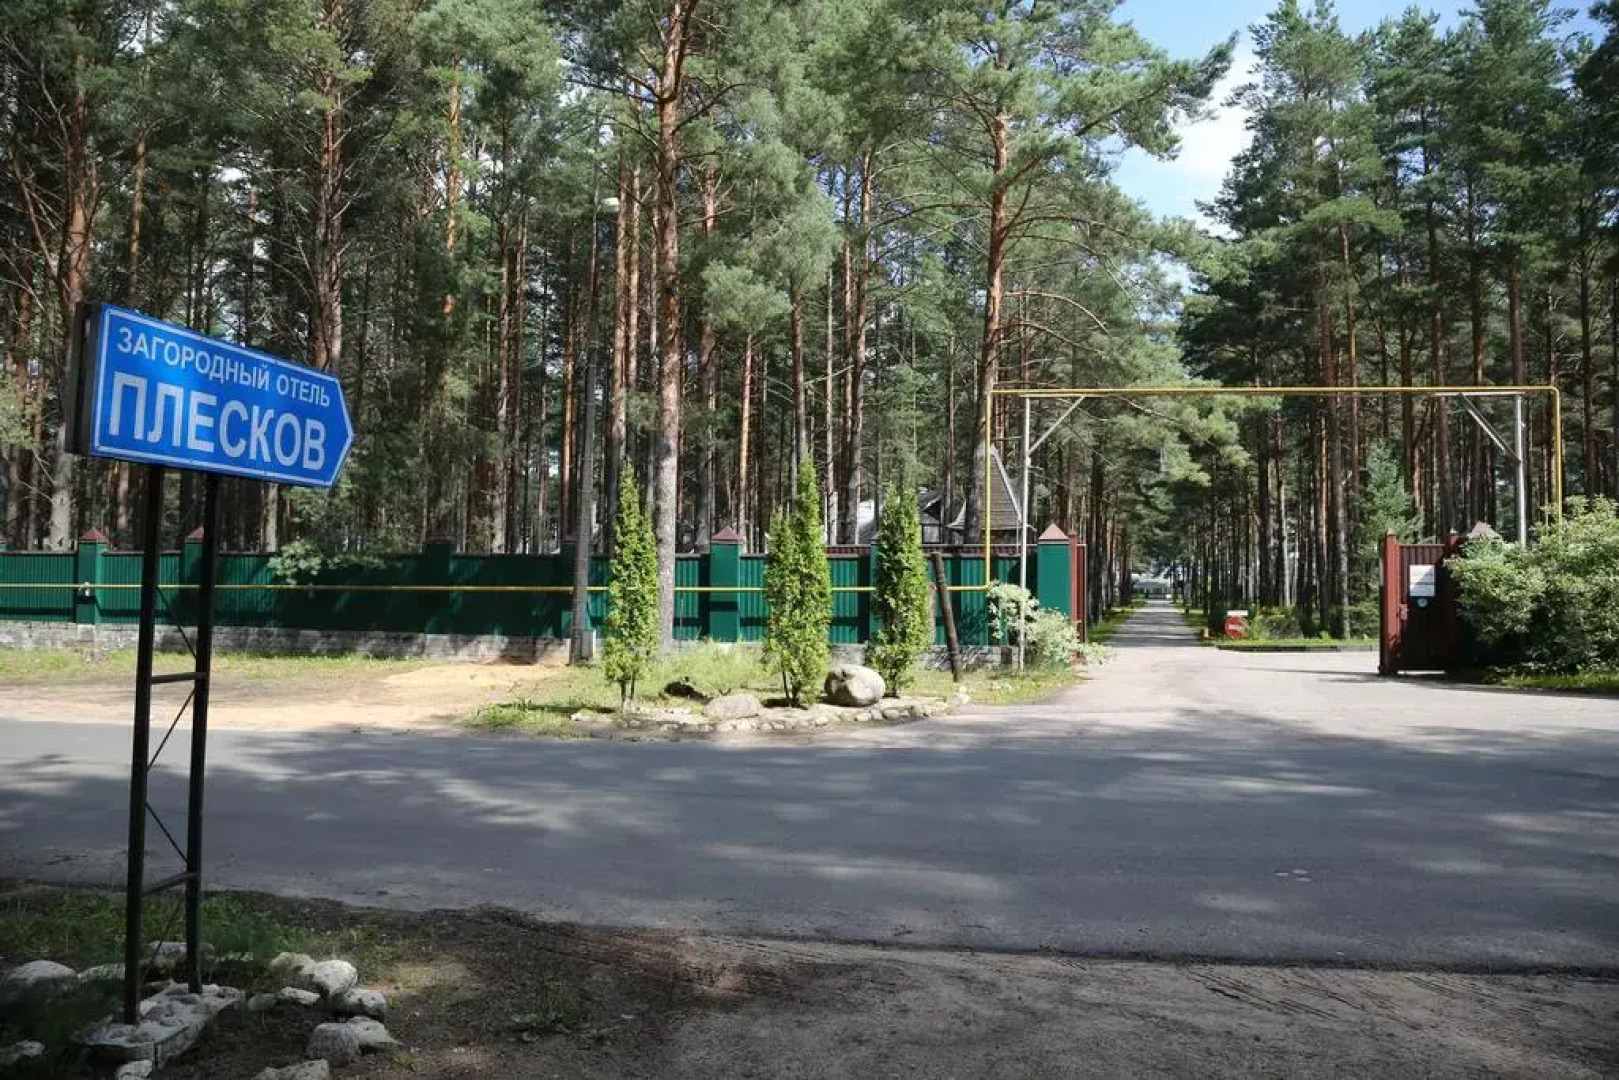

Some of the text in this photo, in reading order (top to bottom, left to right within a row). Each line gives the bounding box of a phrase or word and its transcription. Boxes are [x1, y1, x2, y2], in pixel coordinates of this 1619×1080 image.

[117, 327, 330, 407] ЗАГОРОДНЫЙ ОТЕЛЬ
[109, 371, 326, 471] ПЛЕСКОВ
